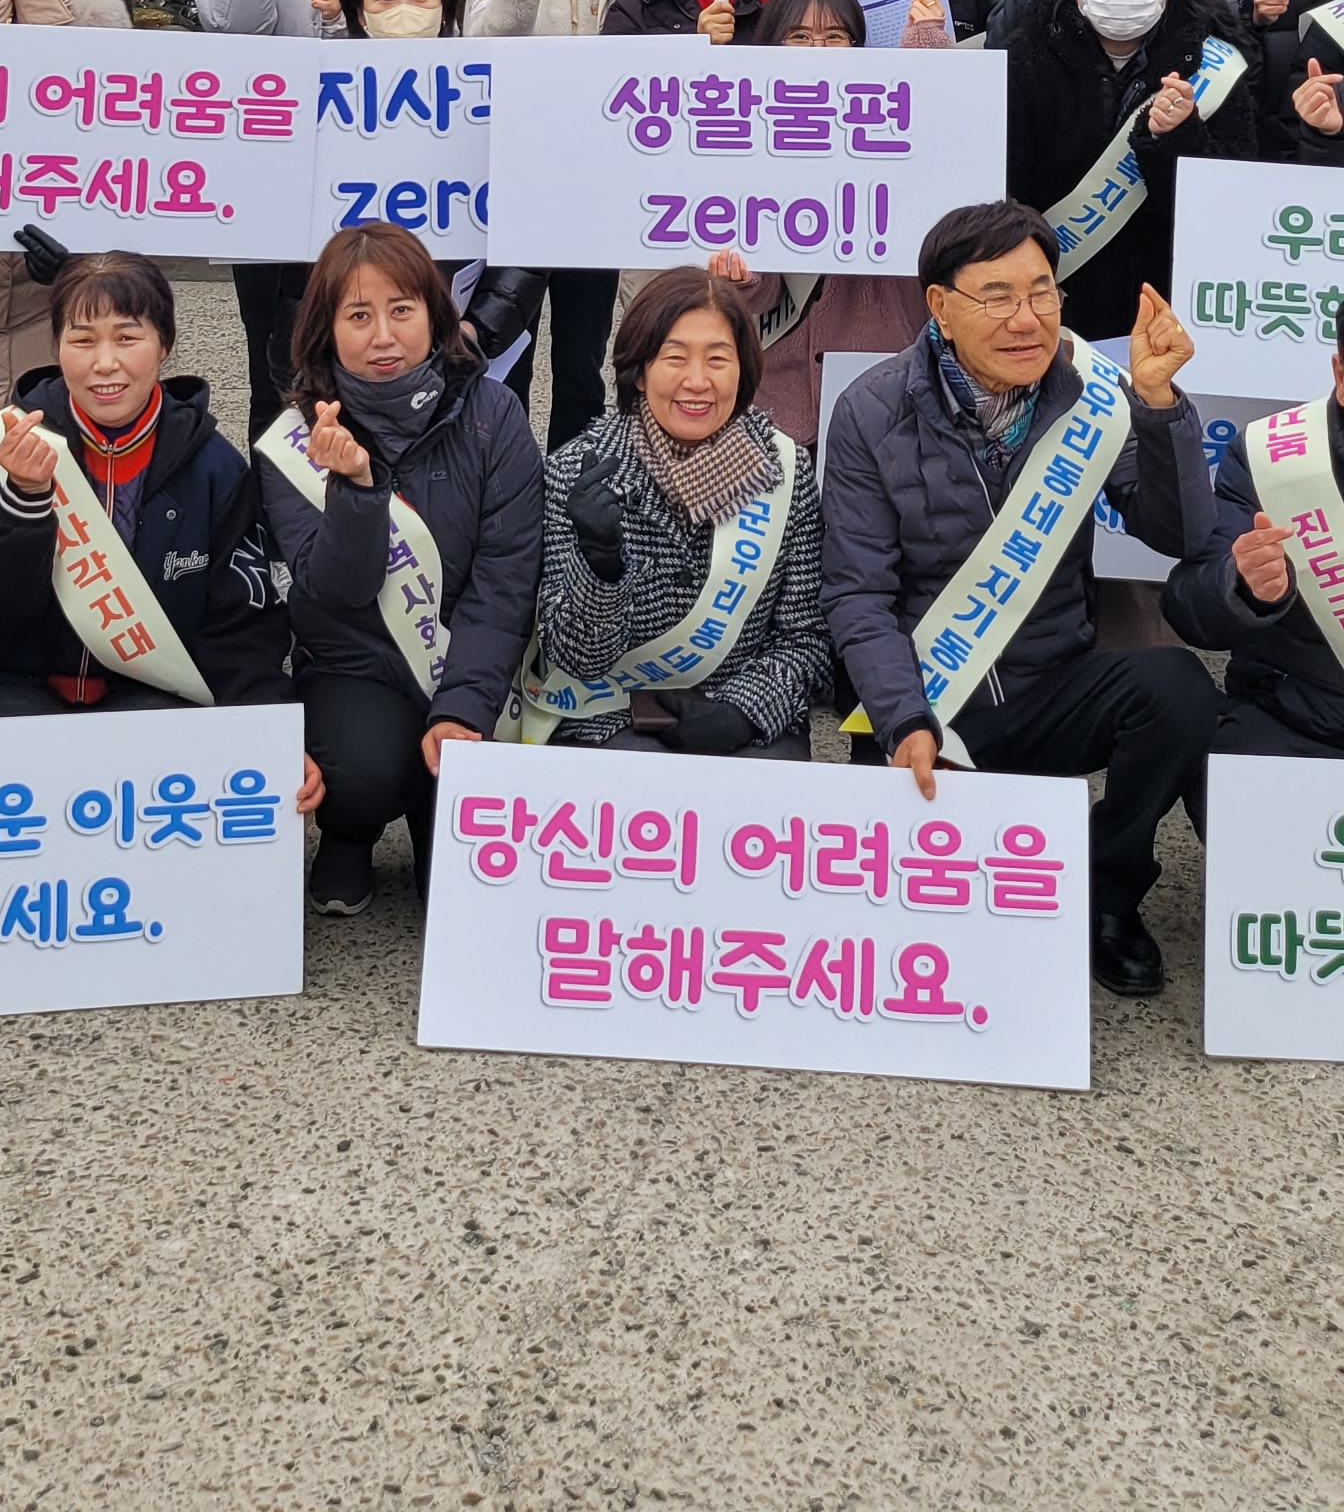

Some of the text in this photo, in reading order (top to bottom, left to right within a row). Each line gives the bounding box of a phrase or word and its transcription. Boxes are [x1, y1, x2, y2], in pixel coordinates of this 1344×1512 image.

[34, 69, 301, 140] 어려움을
[609, 74, 913, 155] 생활불편
[646, 182, 890, 256] zero!!
[71, 769, 282, 847] 이웃을
[459, 796, 1066, 912] 당신의 어려움을
[544, 917, 989, 1027] 말해주세요.
